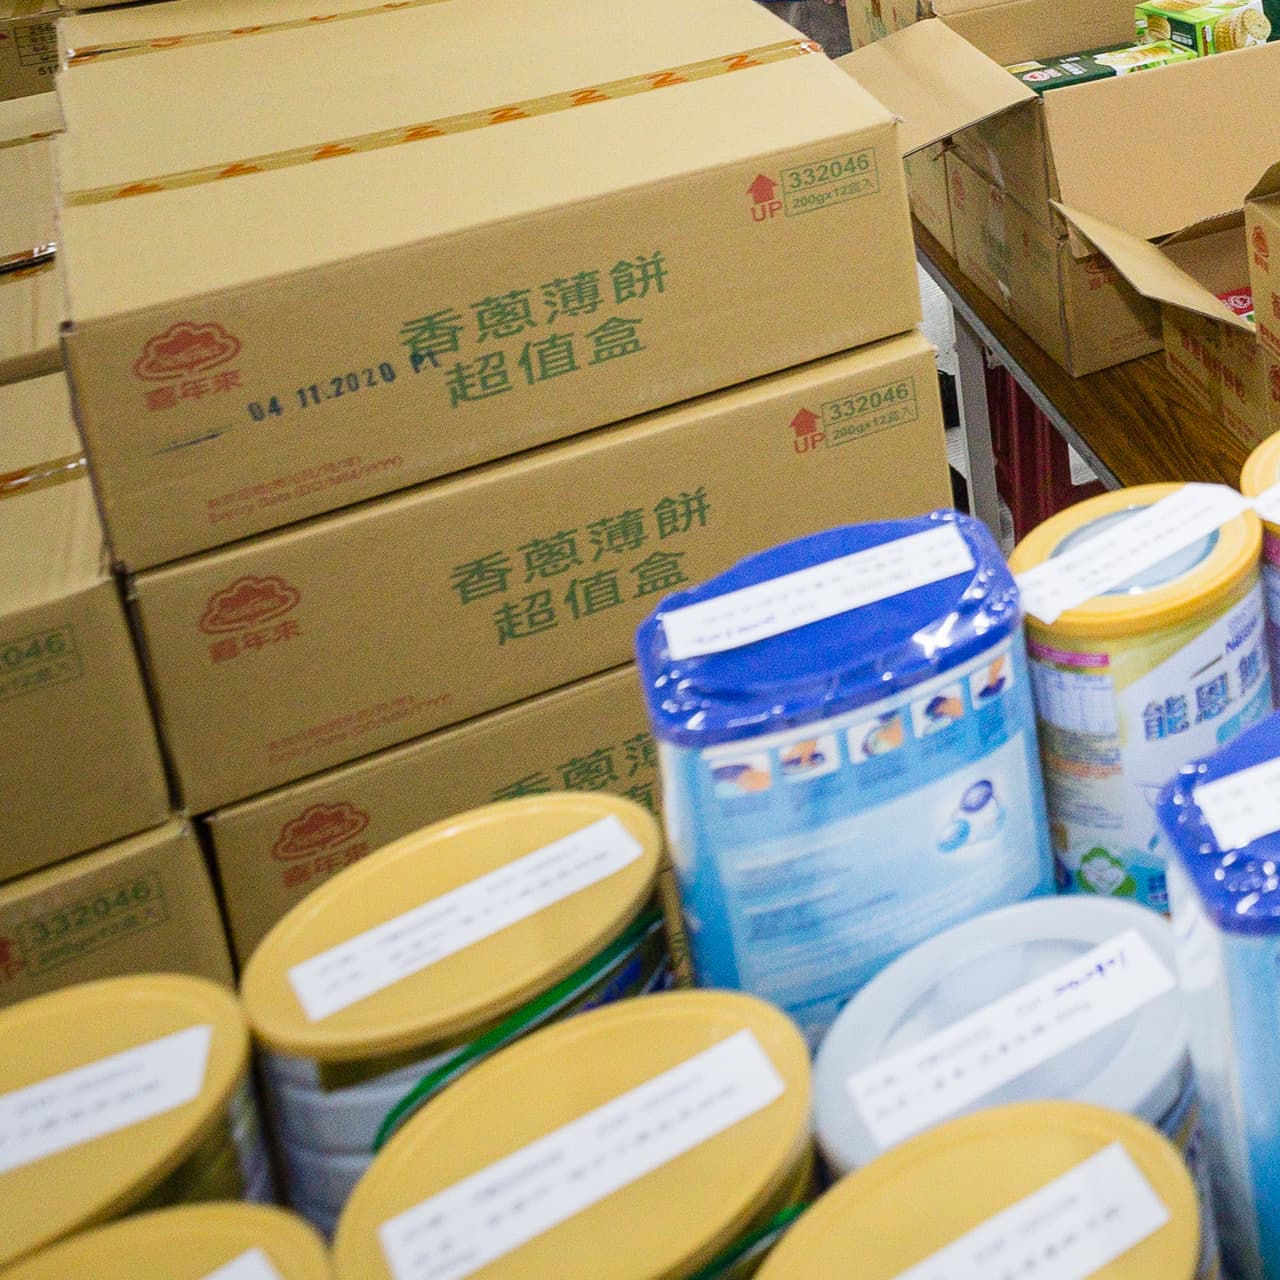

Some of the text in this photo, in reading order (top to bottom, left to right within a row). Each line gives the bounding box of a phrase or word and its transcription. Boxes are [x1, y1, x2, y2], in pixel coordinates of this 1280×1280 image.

[788, 153, 870, 190] 332046
[750, 200, 783, 223] UP
[401, 248, 668, 358] 香蔥薄餅
[444, 316, 646, 409] 超值盒
[828, 383, 908, 421] 332046
[792, 431, 826, 454] UP
[451, 483, 711, 608] 香蔥薄餅
[493, 549, 688, 646] 超值盒
